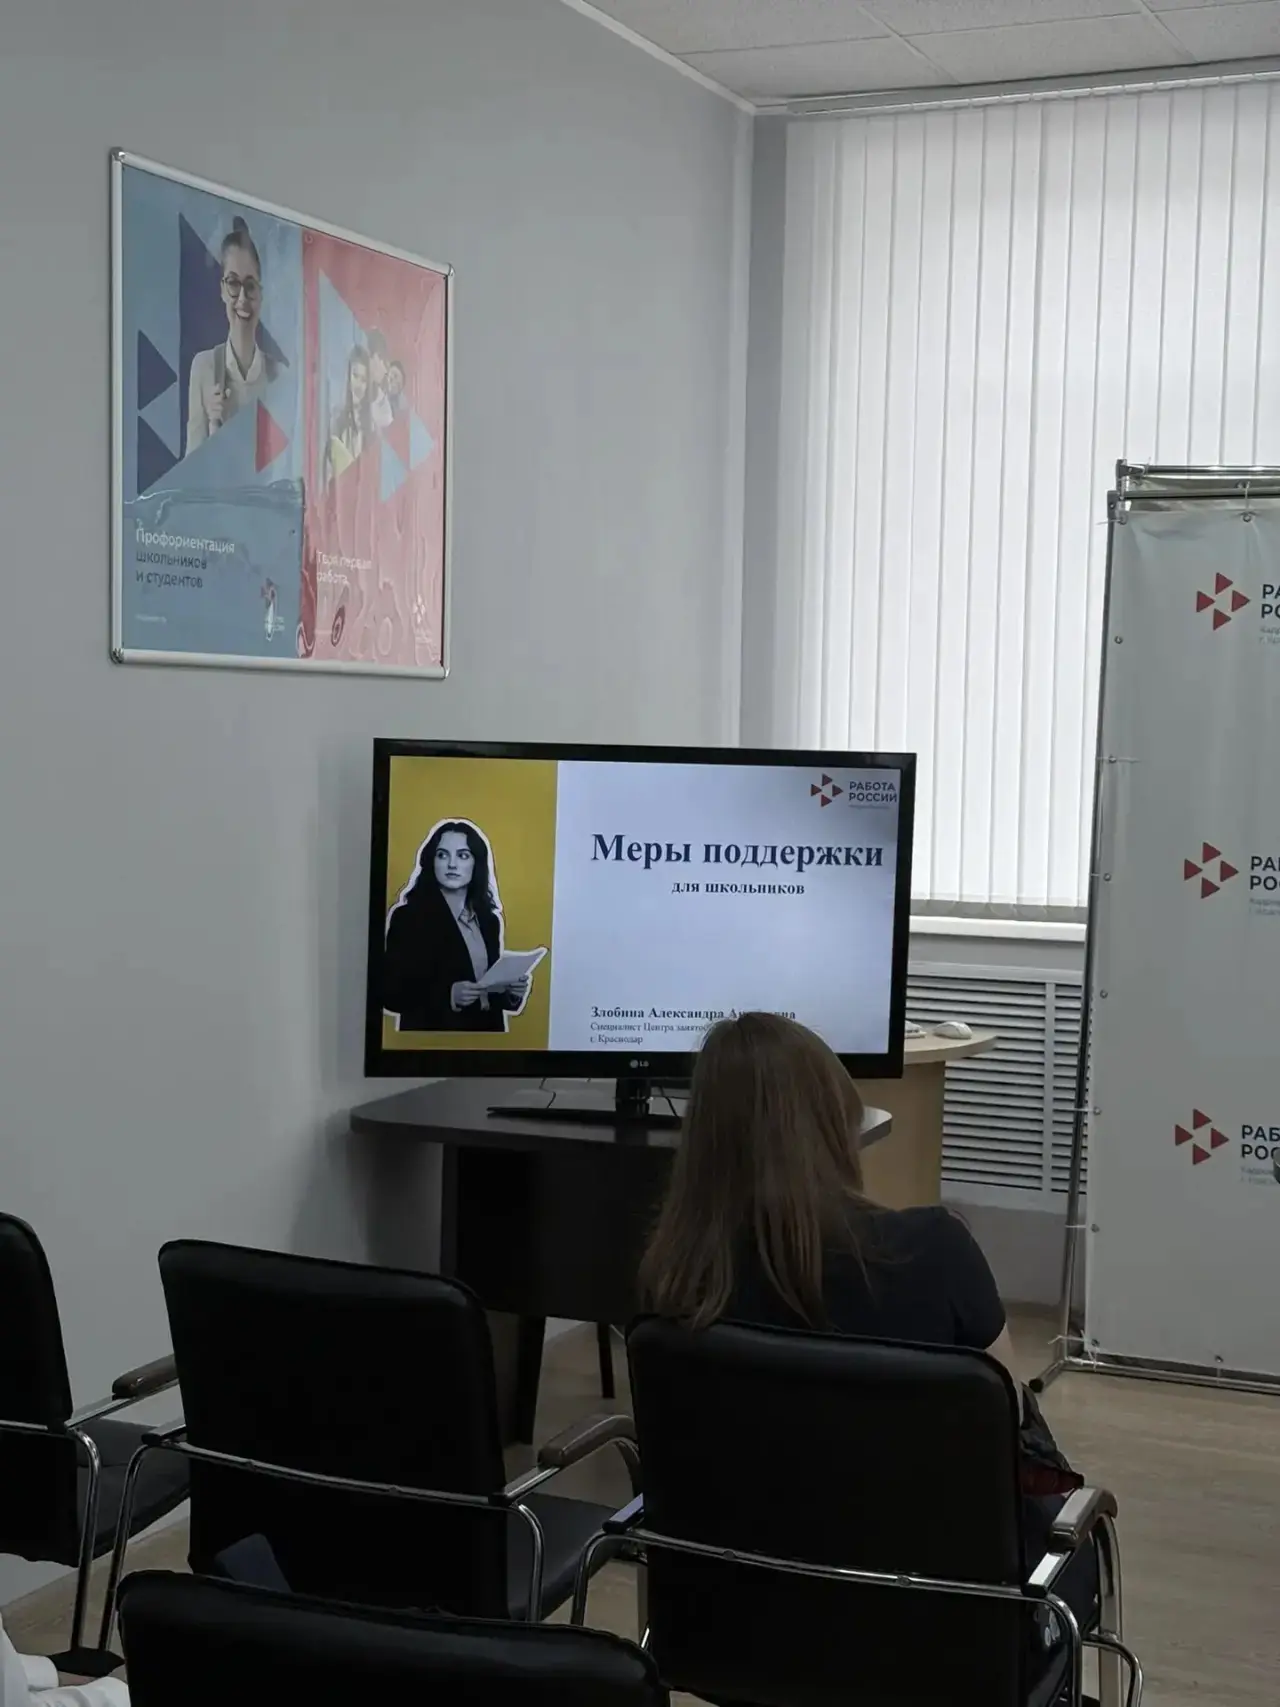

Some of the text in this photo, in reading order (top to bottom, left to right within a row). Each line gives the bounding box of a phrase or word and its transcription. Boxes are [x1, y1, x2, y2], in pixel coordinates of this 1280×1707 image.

[136, 528, 235, 553] Профориентация
[136, 551, 207, 569] школьников
[136, 570, 203, 588] и студентов
[849, 780, 896, 792] РАБОТА
[848, 792, 898, 803] РОССИИ
[591, 833, 884, 872] Меры поддержки
[671, 881, 806, 895] для школьников
[591, 1006, 645, 1018] Злобина
[648, 1007, 725, 1021] Александра
[590, 1022, 641, 1032] Специалист
[643, 1022, 674, 1033] Центра
[598, 1035, 643, 1044] Краснодар
